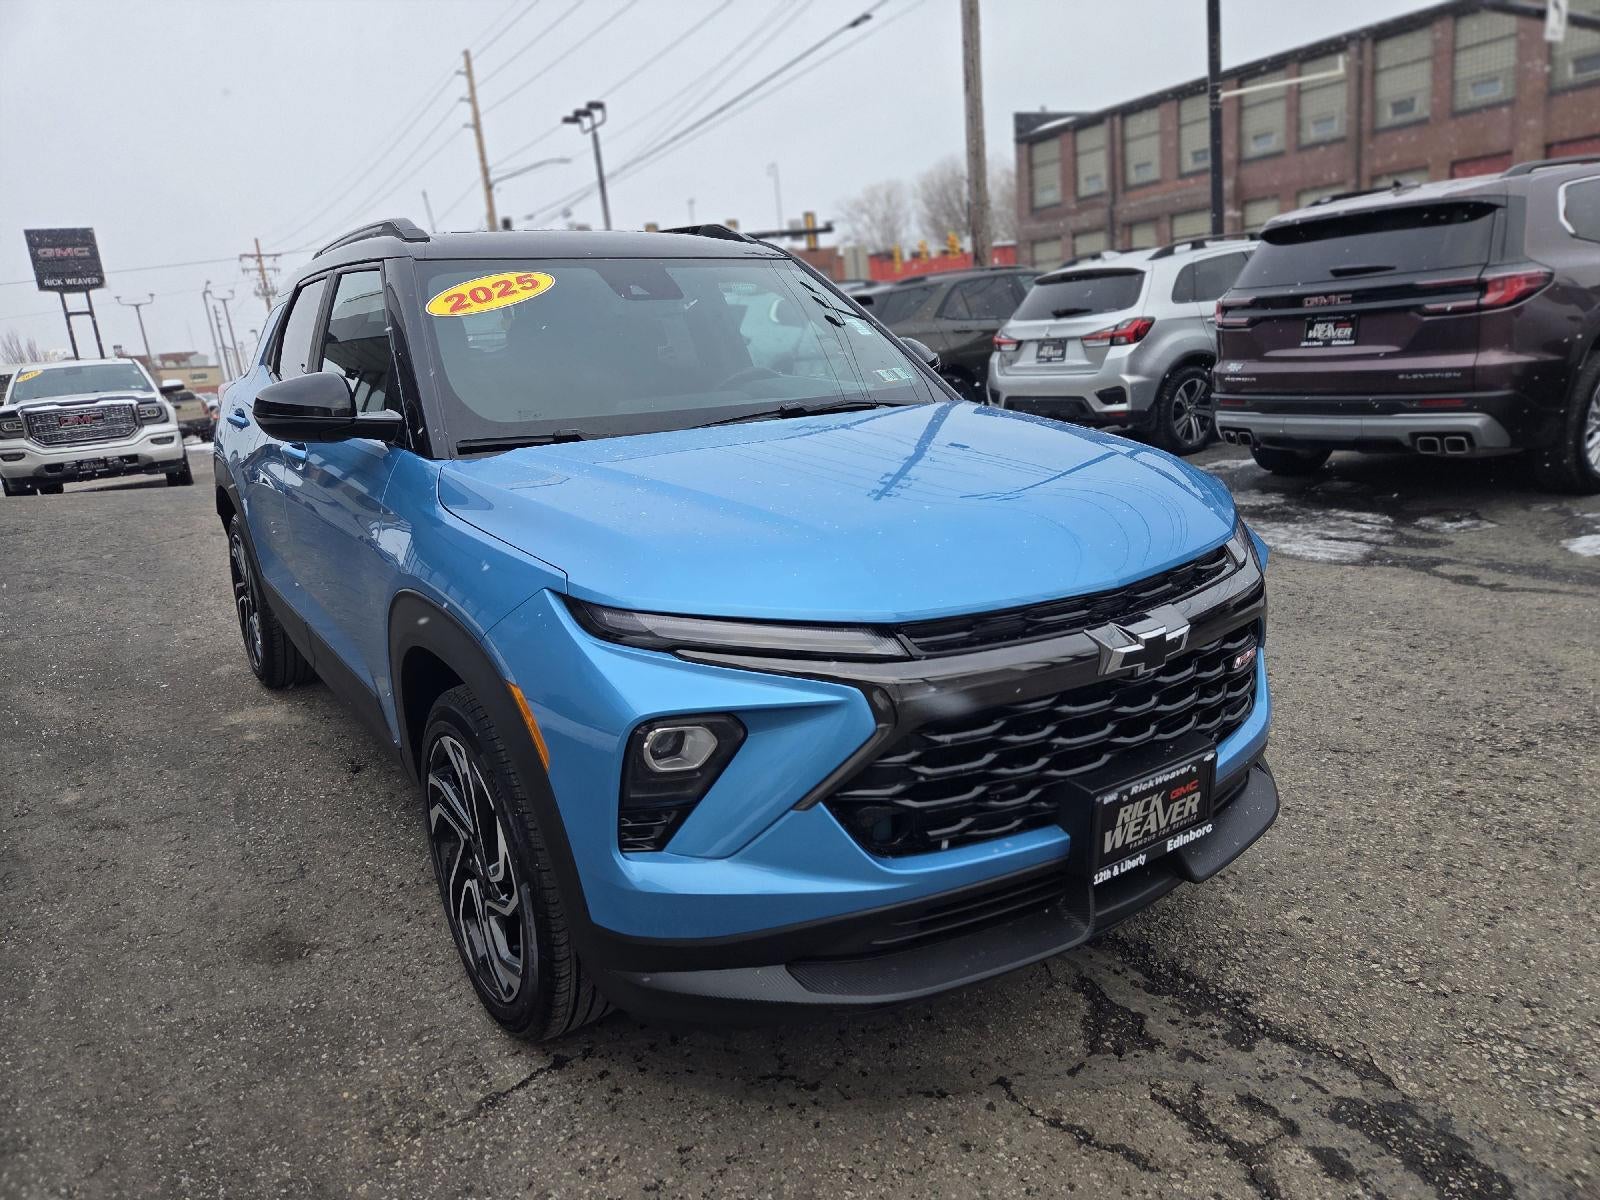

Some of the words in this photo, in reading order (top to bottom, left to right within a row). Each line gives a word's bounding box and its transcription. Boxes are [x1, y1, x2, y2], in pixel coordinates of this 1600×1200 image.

[37, 247, 90, 257] GMC
[44, 278, 63, 286] RICK
[65, 277, 99, 285] WEAVER
[444, 273, 540, 313] 2025
[1303, 294, 1352, 306] GMC
[1398, 372, 1462, 380] ELEVATION
[59, 413, 104, 426] GMC
[1169, 779, 1199, 800] GMC
[1115, 790, 1166, 828] RICK
[1104, 791, 1201, 854] WEAVER
[1129, 833, 1157, 850] FAMOUS
[1158, 826, 1171, 837] FOR
[1172, 814, 1198, 831] SERVICE
[1093, 870, 1112, 886] 12th
[1112, 865, 1119, 877] &
[1120, 853, 1147, 873] Liberty
